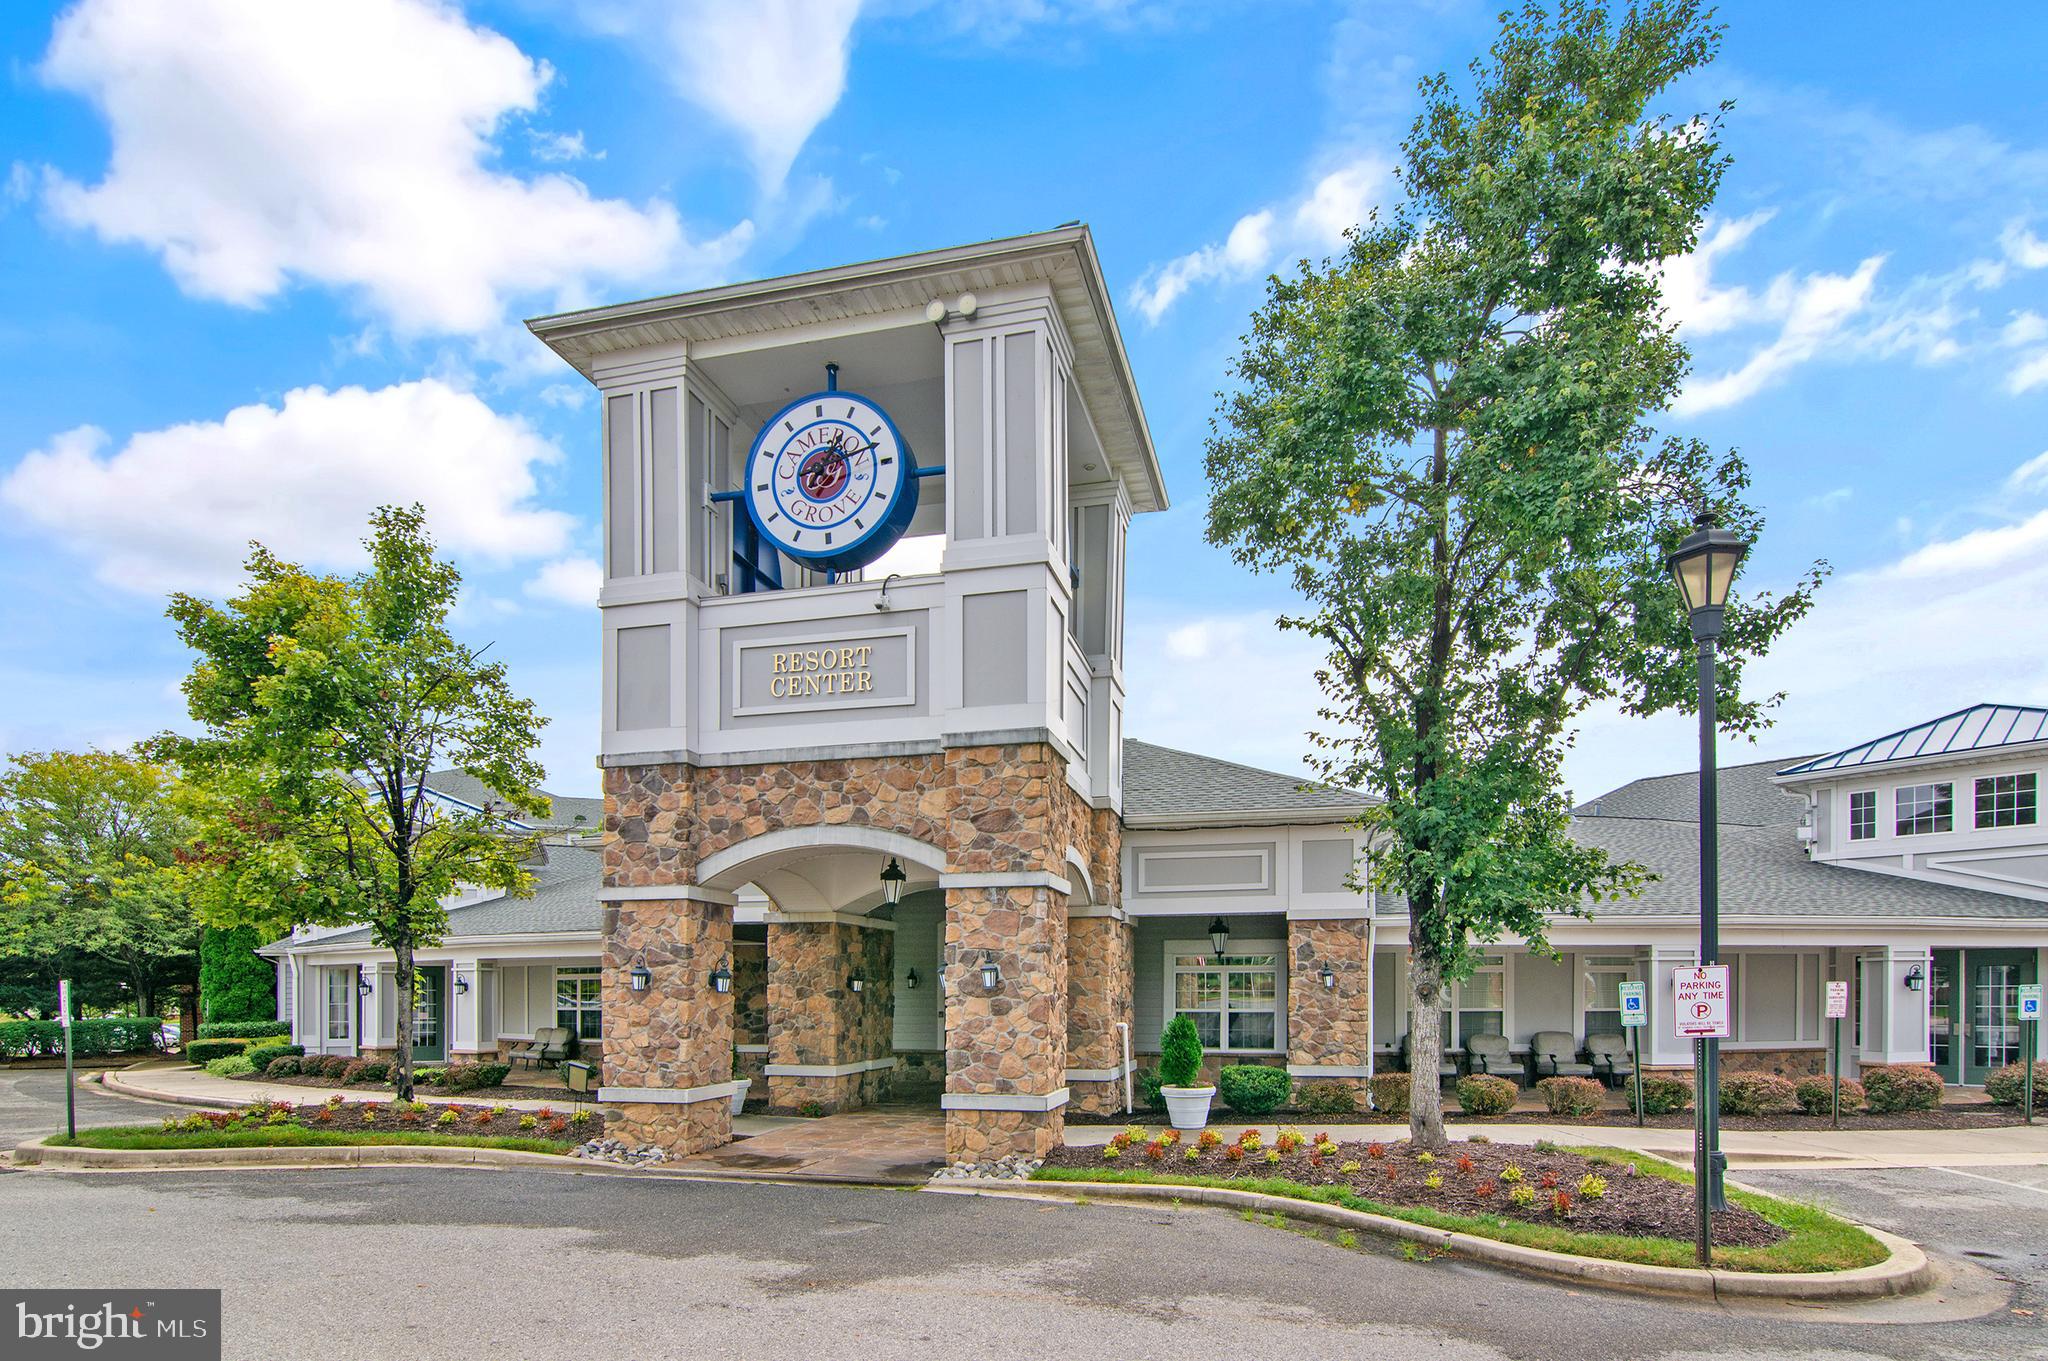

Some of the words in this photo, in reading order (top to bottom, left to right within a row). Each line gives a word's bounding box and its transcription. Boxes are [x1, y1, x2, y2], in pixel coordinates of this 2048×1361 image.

[778, 426, 870, 480] CAMERON
[790, 488, 862, 523] GROVE
[771, 645, 873, 675] RESORT
[769, 670, 874, 698] CENTER
[1680, 981, 1721, 990] PARKING
[1693, 971, 1707, 980] NO
[1678, 992, 1698, 1001] ANY
[1703, 991, 1724, 1000] TIME
